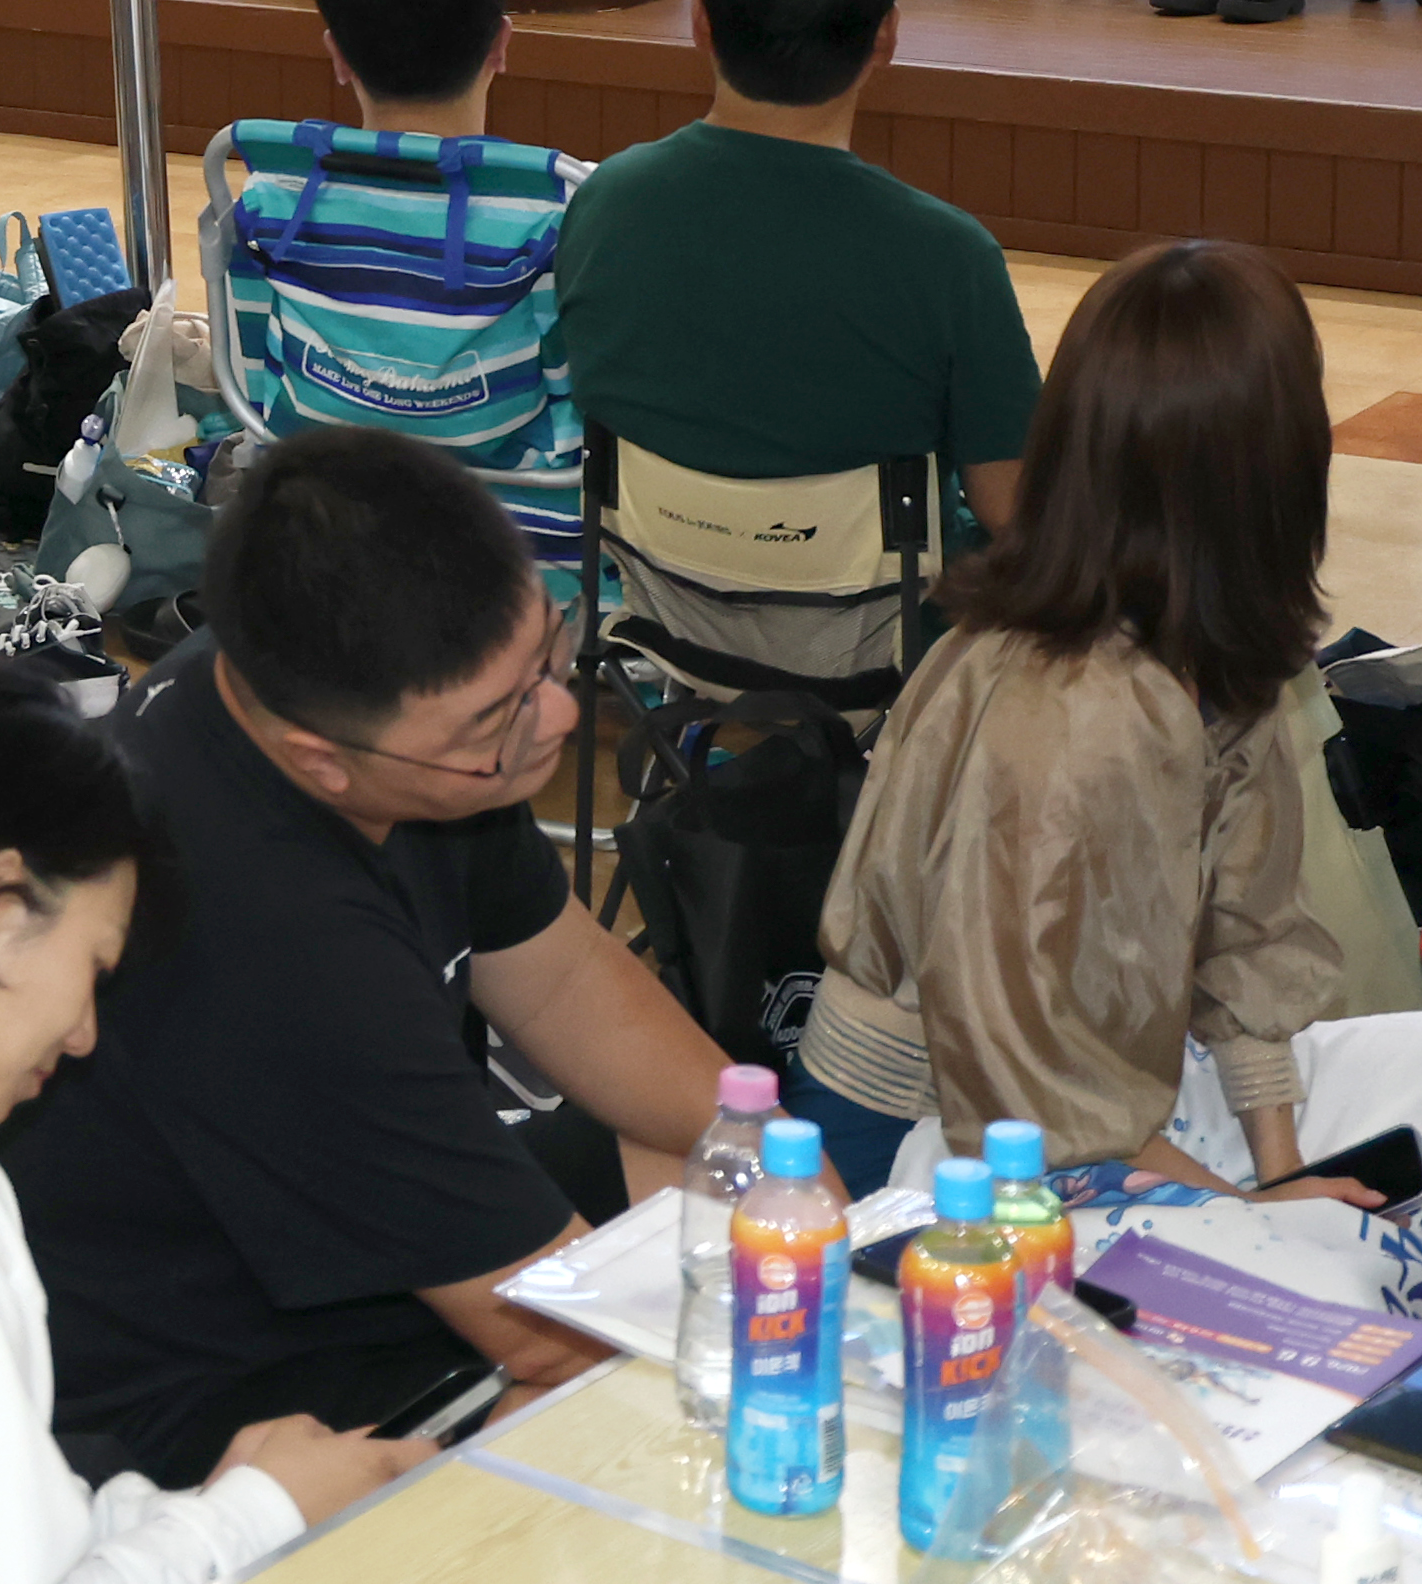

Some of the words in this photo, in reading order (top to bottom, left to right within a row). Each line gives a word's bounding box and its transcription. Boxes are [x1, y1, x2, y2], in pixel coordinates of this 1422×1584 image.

[311, 362, 341, 383] MAKE
[384, 393, 413, 408] LONG
[753, 532, 801, 543] KOVEA
